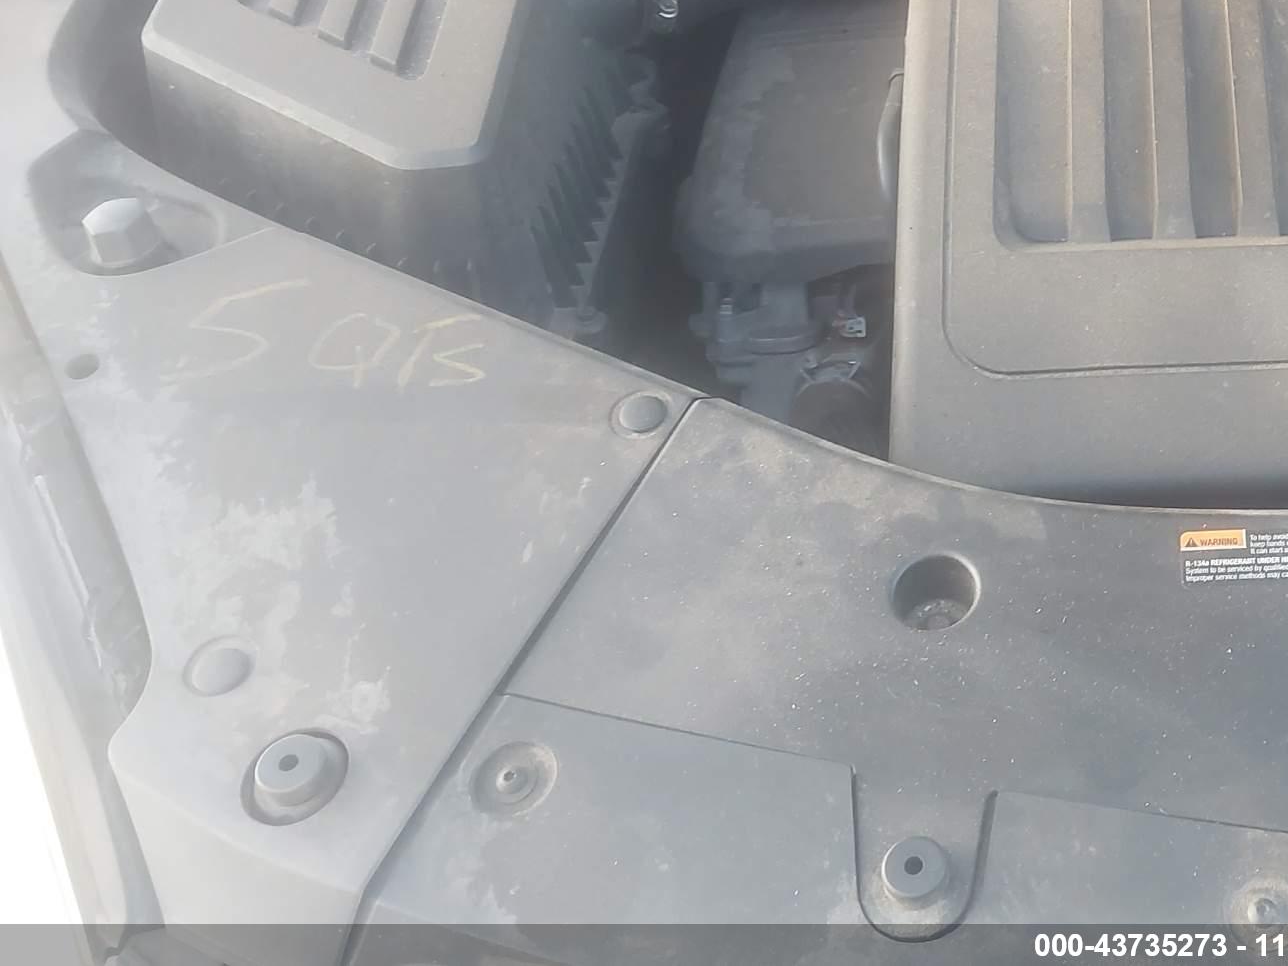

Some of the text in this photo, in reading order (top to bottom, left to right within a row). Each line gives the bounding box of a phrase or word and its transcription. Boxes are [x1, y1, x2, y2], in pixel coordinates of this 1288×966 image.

[1258, 533, 1272, 541] help
[1200, 538, 1238, 546] WARNING
[1210, 558, 1256, 566] REFRIGERANT
[1257, 556, 1280, 564] UNDER
[1185, 567, 1209, 576] System
[1227, 565, 1253, 573] serviced
